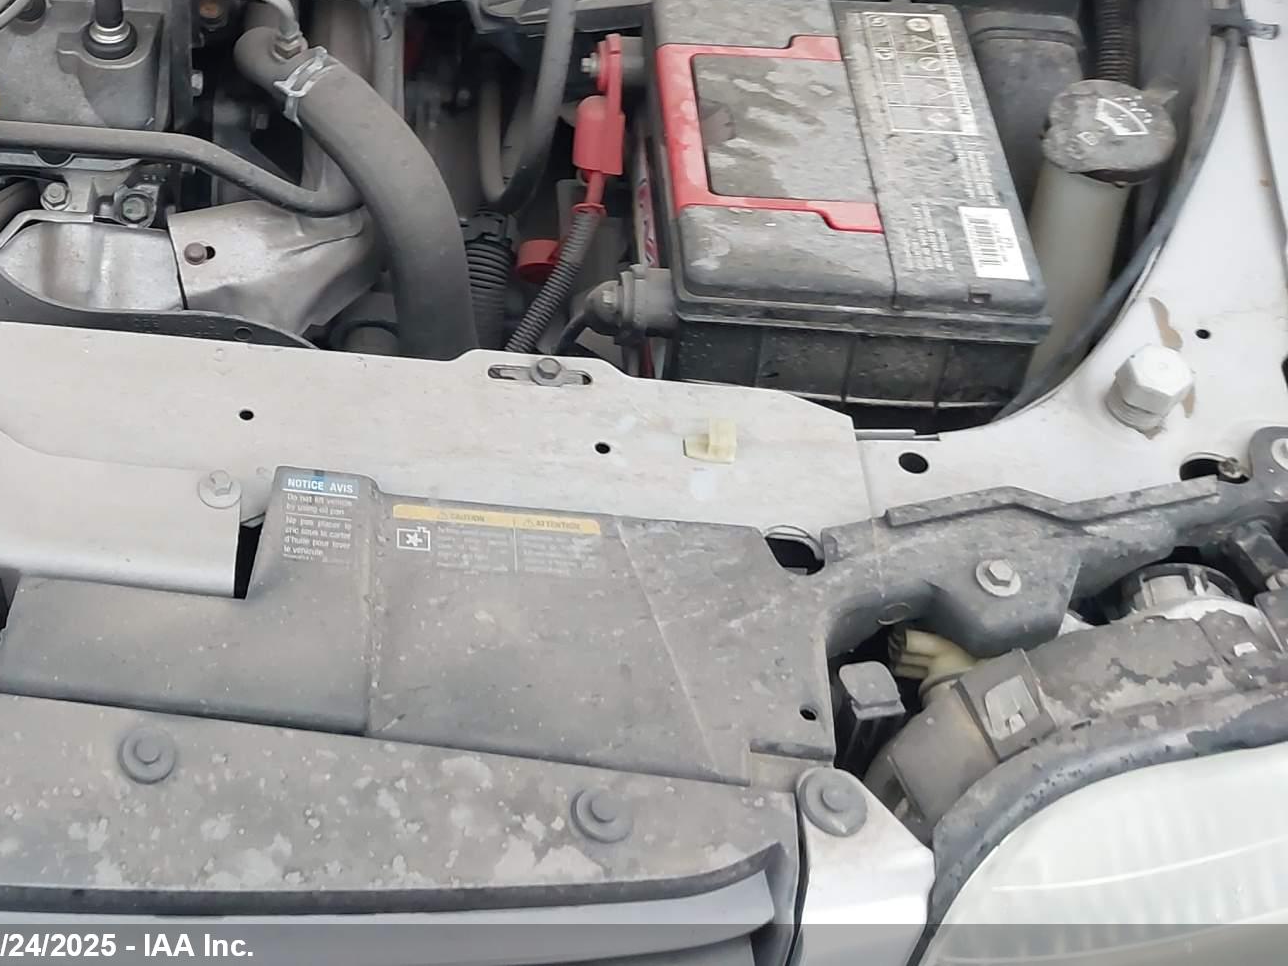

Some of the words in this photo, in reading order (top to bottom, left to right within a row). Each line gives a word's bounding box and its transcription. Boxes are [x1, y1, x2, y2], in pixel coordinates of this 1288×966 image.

[287, 477, 324, 490] NOTICE
[329, 482, 354, 494] AVIS
[449, 512, 486, 523] CAUTION
[535, 519, 581, 531] ATTENTION
